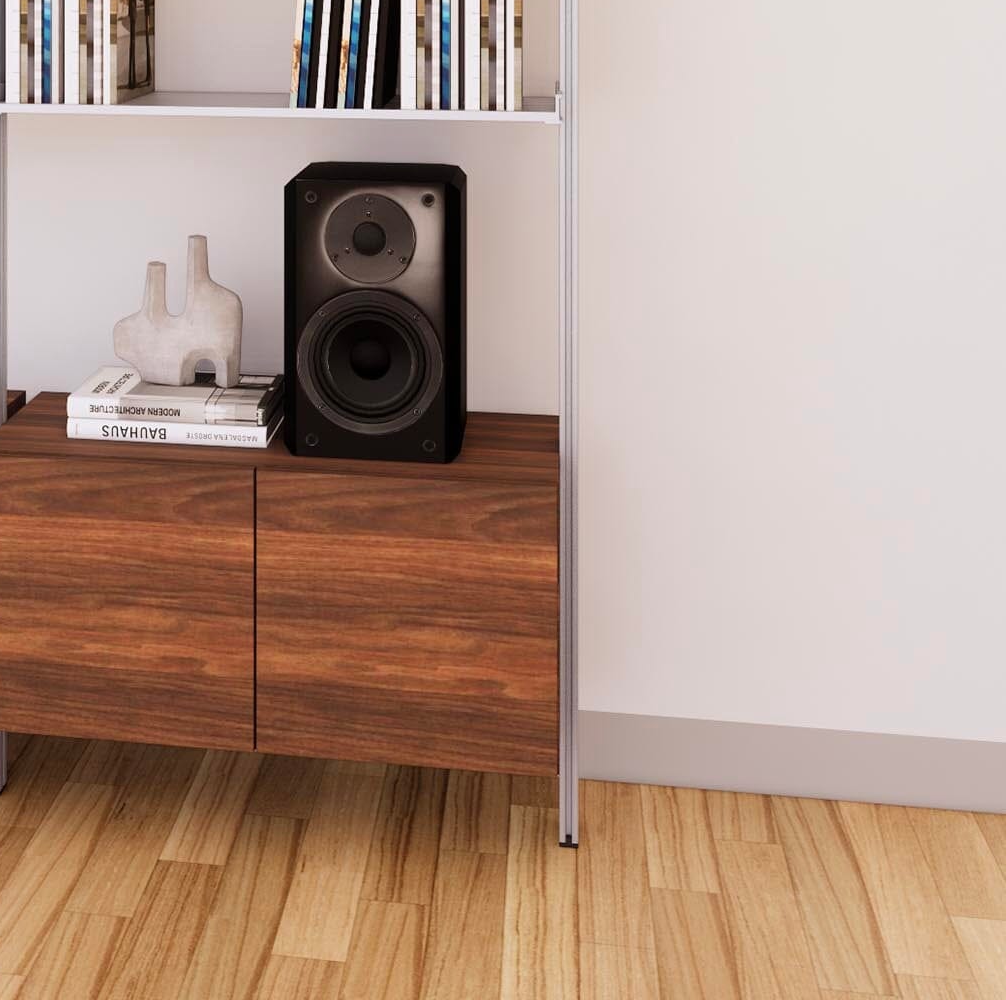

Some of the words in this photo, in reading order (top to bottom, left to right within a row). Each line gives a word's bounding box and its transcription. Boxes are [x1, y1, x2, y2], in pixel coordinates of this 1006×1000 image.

[89, 404, 146, 416] ARCHITECTURE
[148, 406, 180, 416] MODERN
[102, 424, 166, 439] BAUHAUS
